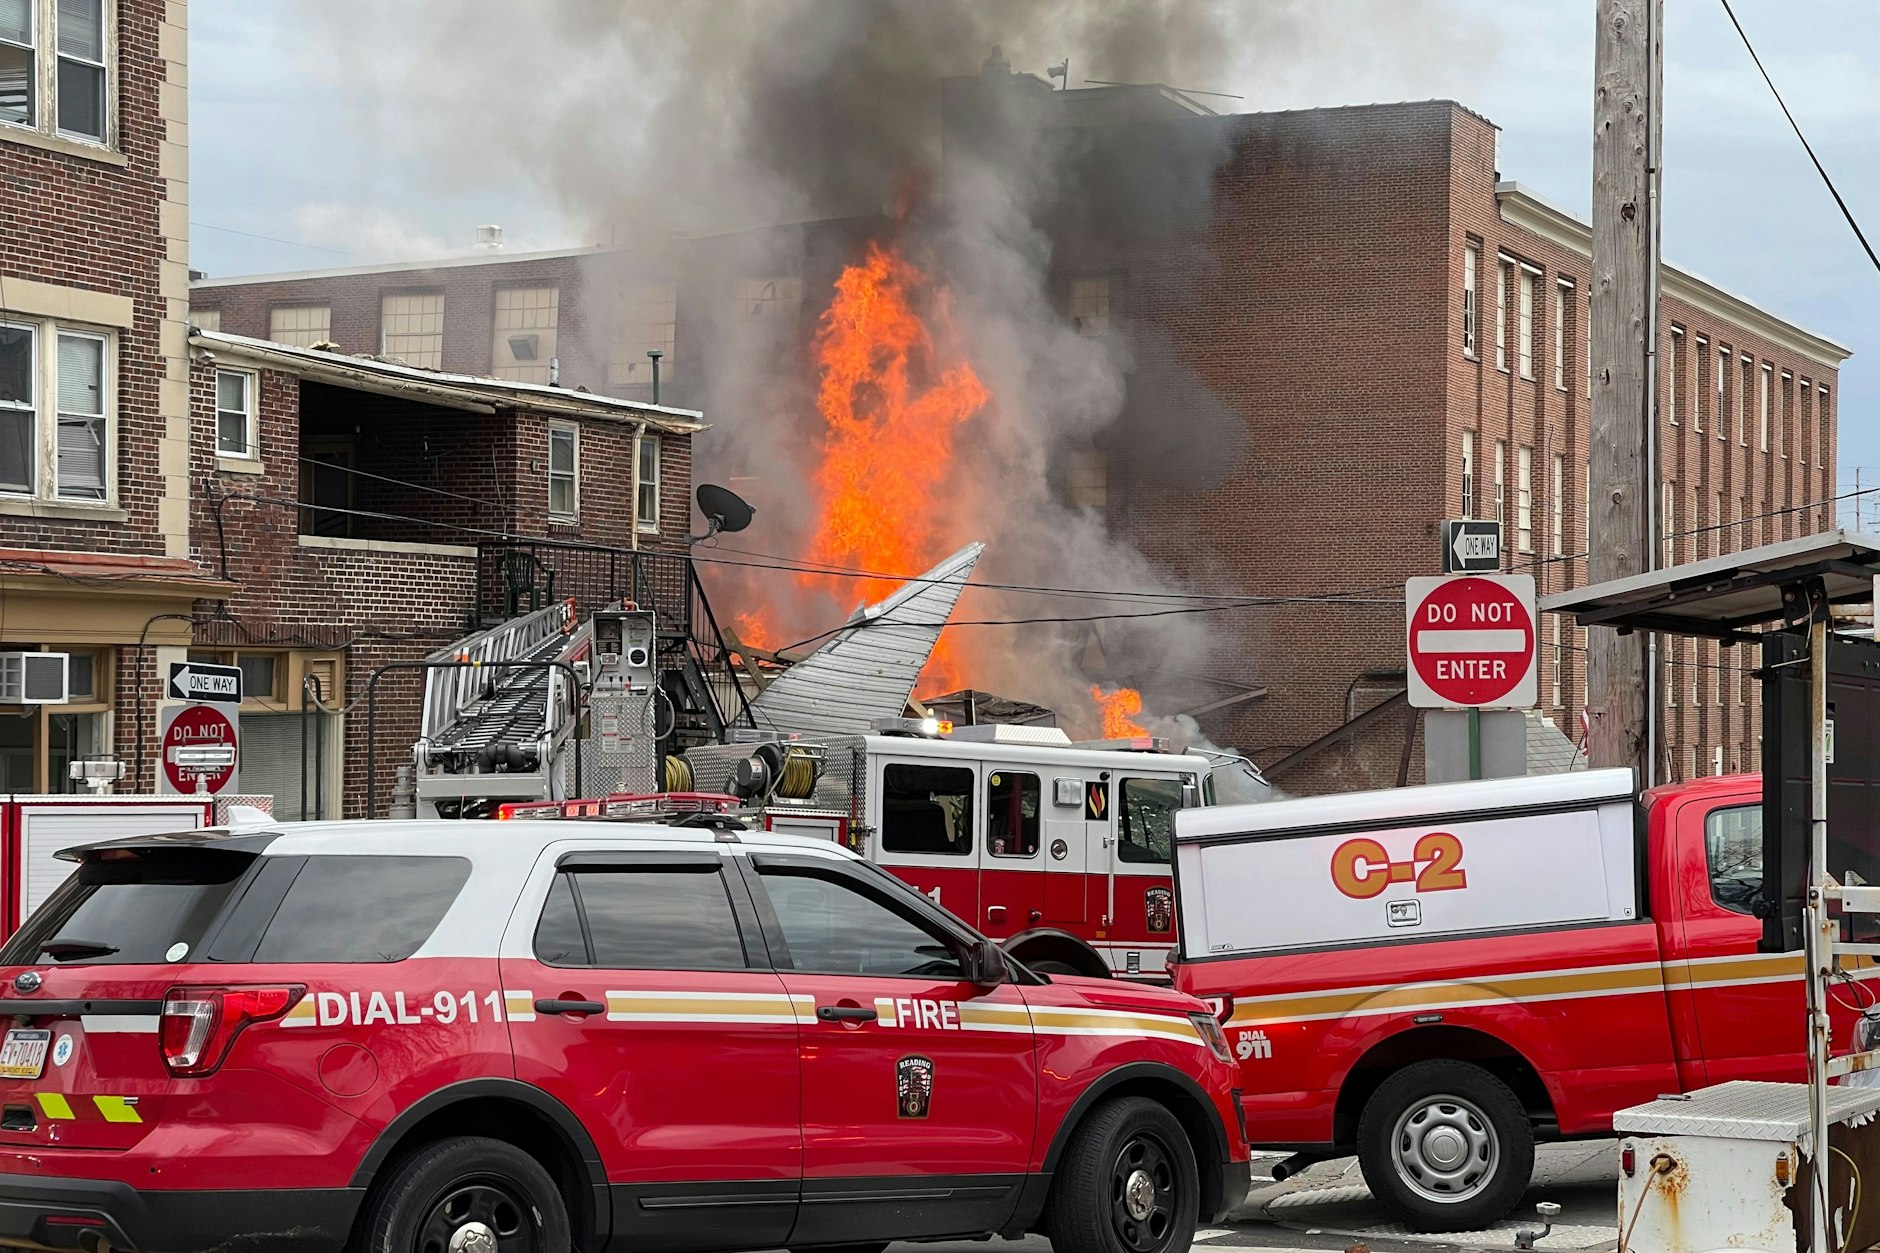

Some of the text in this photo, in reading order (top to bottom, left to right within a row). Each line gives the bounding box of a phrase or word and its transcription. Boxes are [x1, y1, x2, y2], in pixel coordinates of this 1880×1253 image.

[1465, 537, 1495, 556] ONE WAY
[1427, 602, 1514, 623] DO NOT
[1436, 660, 1506, 680] ENTER
[190, 675, 233, 692] ONE WAY
[173, 723, 226, 741] DO NOT
[1330, 832, 1467, 899] C-2
[317, 990, 503, 1027] DIAL-911
[895, 998, 959, 1030] FIRE
[1239, 1030, 1267, 1041] DIAL
[1236, 1040, 1272, 1060] 911
[899, 1059, 931, 1069] READING
